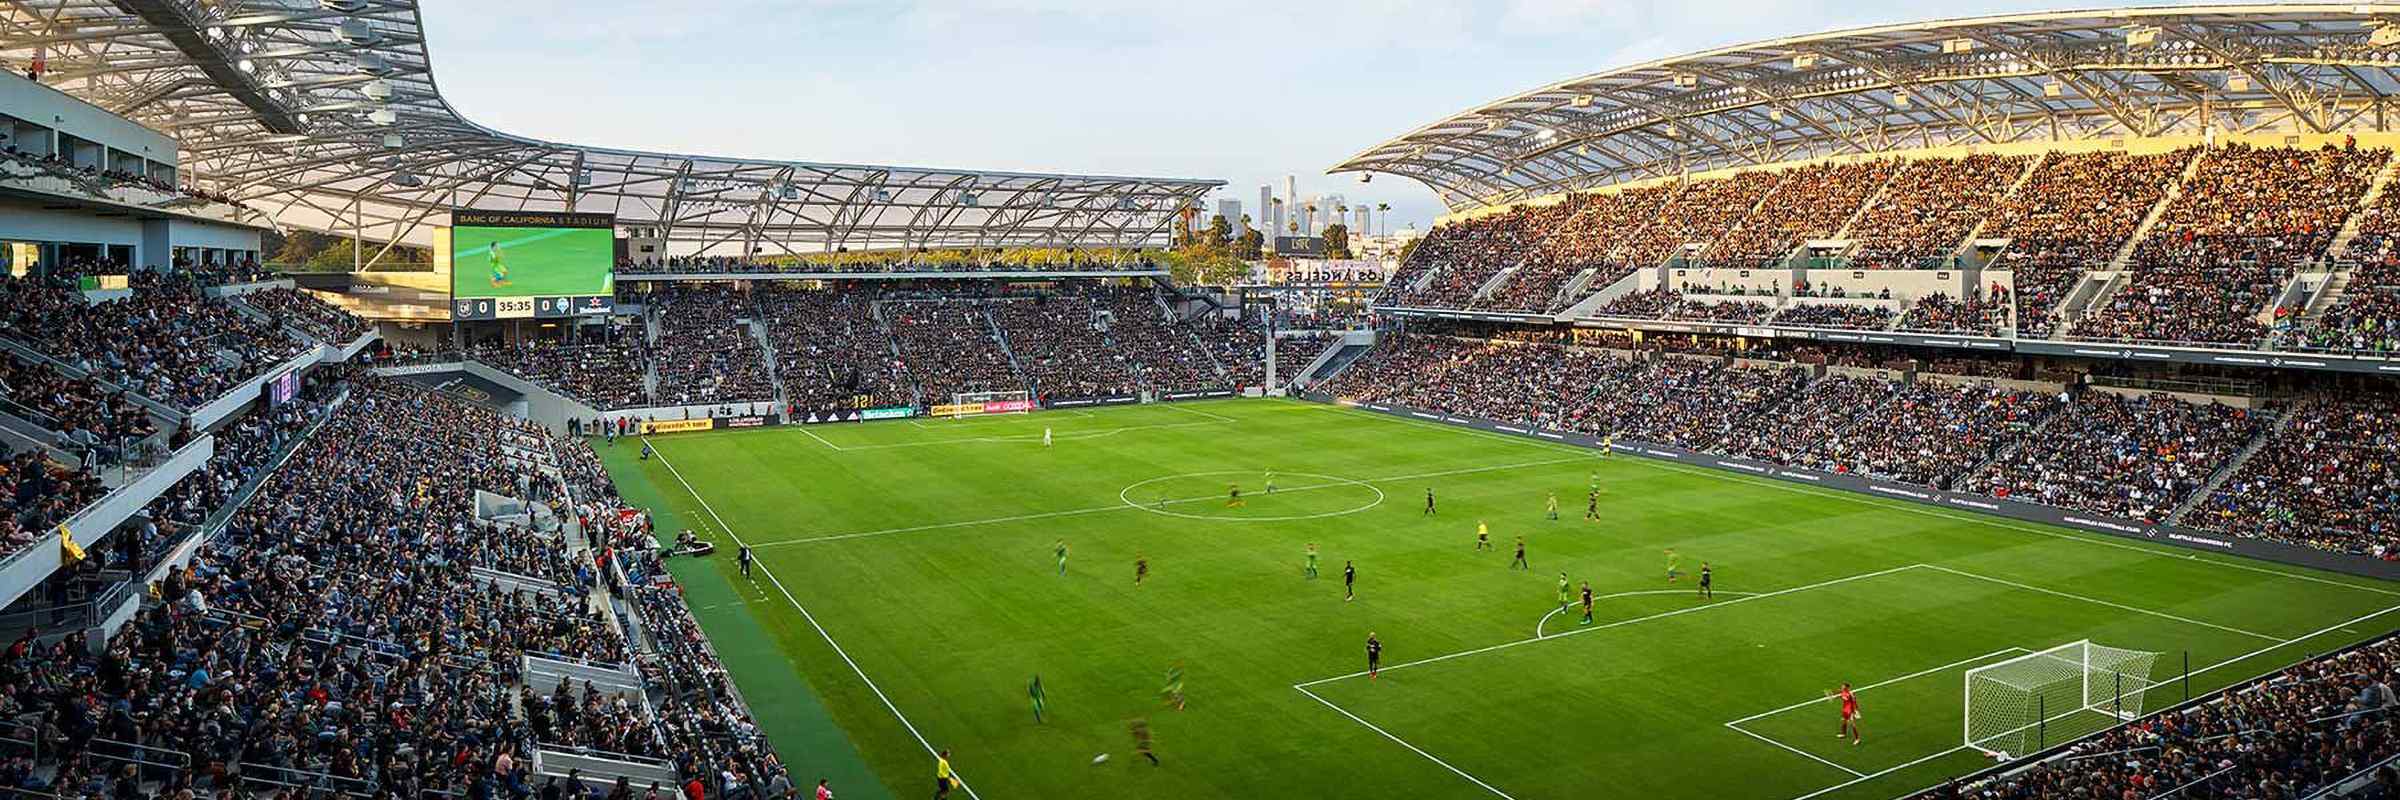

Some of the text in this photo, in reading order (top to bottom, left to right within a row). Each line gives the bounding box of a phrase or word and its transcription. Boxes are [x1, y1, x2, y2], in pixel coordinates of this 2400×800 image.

[460, 215, 609, 225] BANC OF CALIFORNIA STADIUM
[480, 301, 488, 313] 0
[499, 301, 531, 312] 35:35
[542, 300, 549, 311] 0
